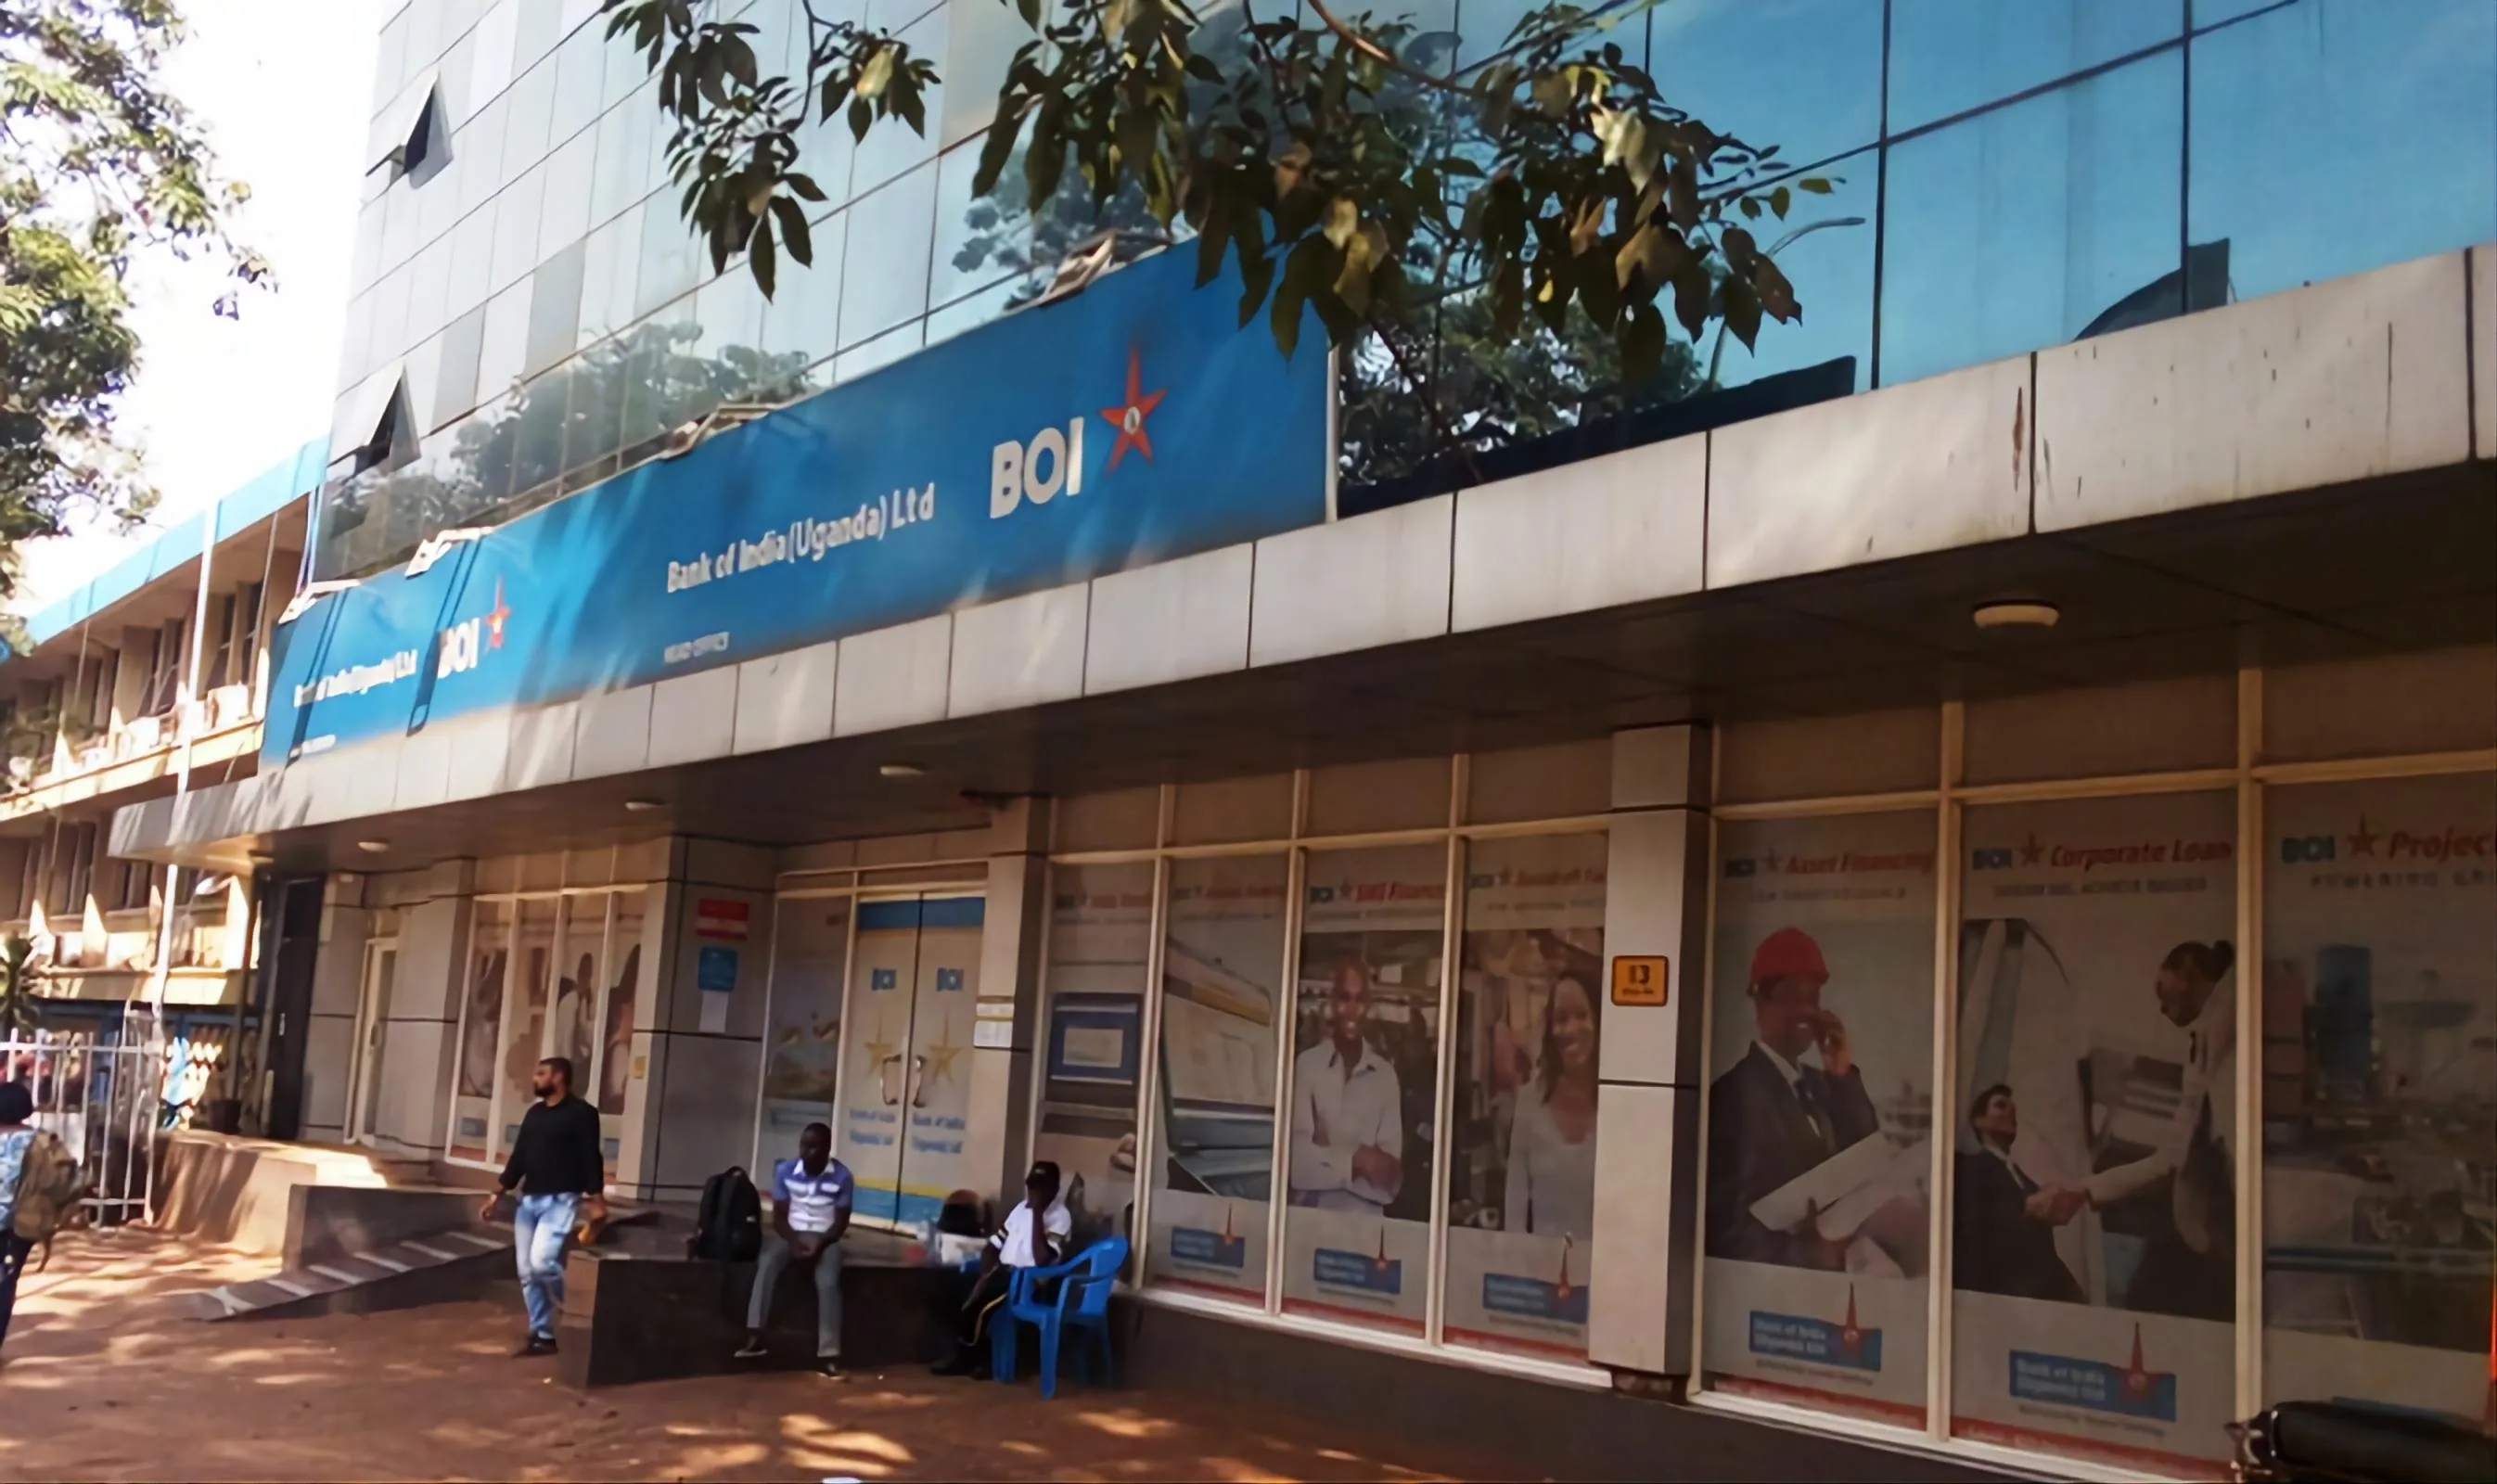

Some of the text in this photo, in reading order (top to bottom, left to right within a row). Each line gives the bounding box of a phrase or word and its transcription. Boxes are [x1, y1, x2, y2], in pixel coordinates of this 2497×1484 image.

[990, 416, 1084, 519] BOI
[667, 552, 712, 594] Bank
[715, 543, 736, 579] of
[891, 481, 936, 530] Ltd
[2388, 826, 2497, 864] Projec
